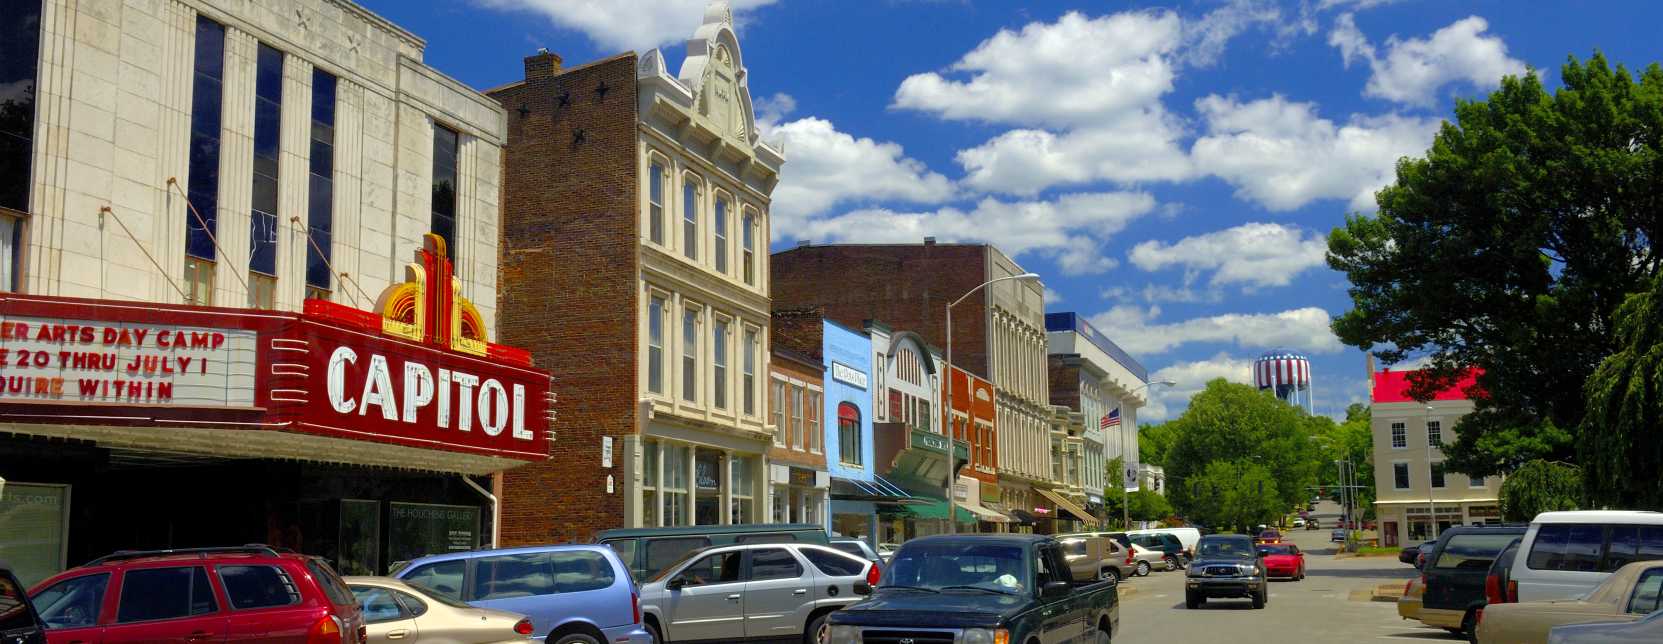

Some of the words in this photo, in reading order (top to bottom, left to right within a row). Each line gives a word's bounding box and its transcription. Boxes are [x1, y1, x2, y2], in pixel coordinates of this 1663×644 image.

[36, 324, 95, 344] ARTS
[103, 327, 148, 348] DAY
[156, 330, 225, 351] CAMP
[16, 349, 50, 368] 20
[59, 351, 116, 371] THRU
[127, 355, 192, 376] JULY
[79, 378, 173, 401] WITHIN
[327, 346, 534, 440] CAPITOL
